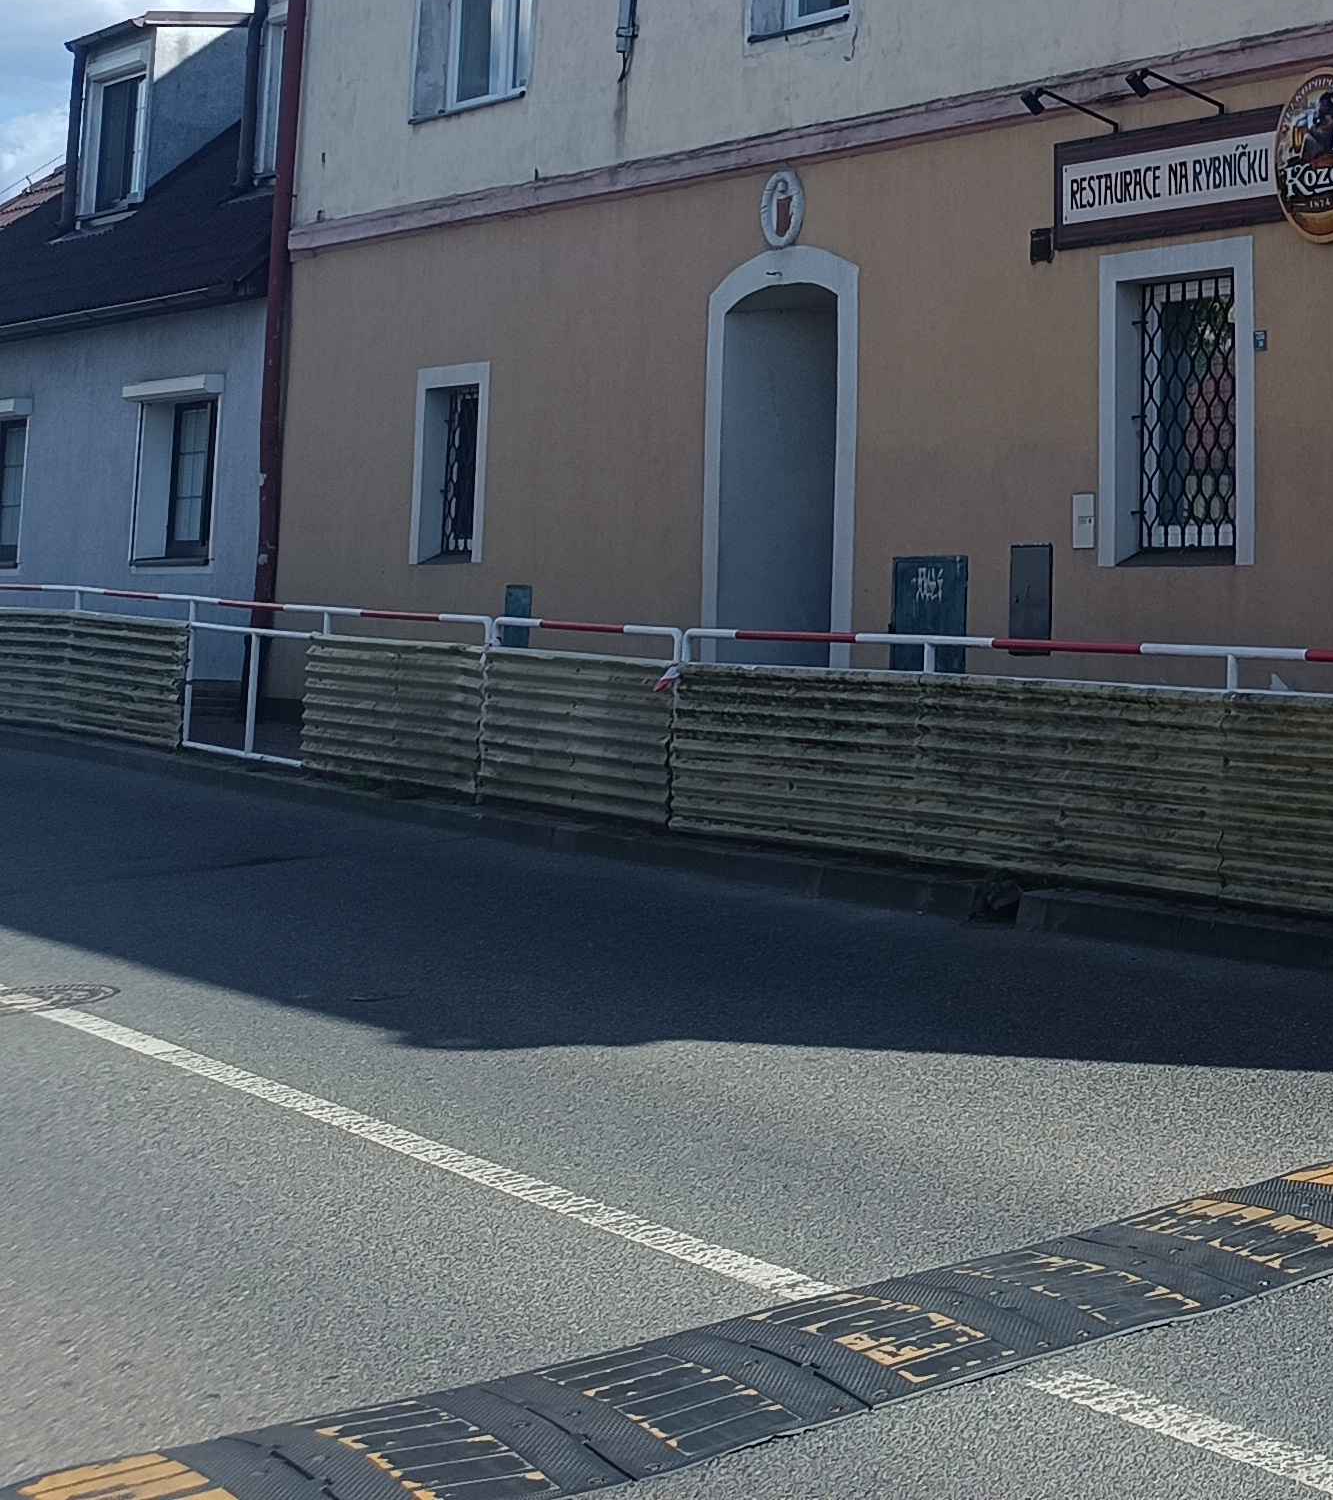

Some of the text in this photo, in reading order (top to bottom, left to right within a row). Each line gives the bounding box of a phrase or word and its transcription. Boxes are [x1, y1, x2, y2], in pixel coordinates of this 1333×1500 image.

[1070, 143, 1269, 210] RESTAURACE NA RYBNÍČKU
